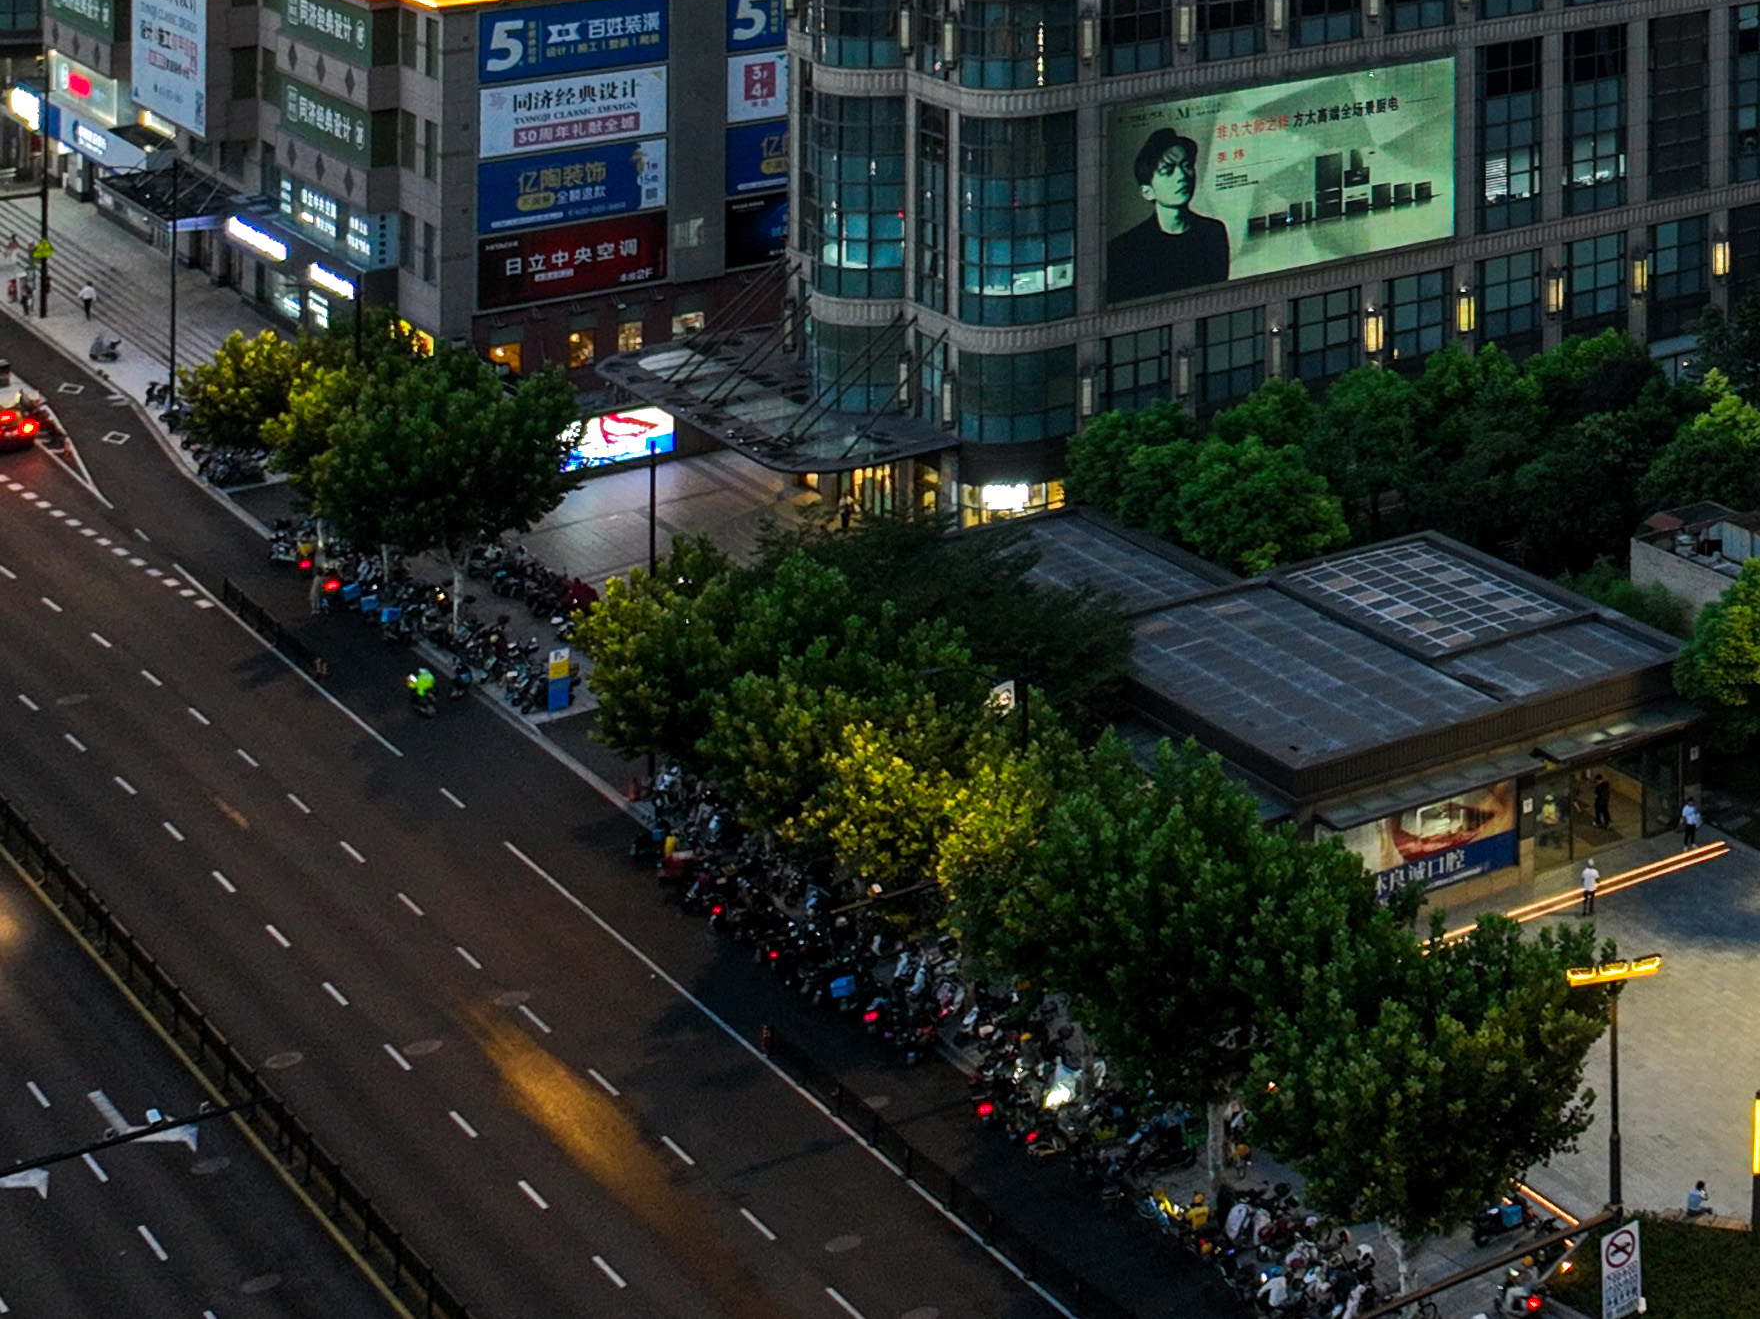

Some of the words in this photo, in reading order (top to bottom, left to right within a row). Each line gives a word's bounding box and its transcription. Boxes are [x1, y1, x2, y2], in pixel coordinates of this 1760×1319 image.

[588, 11, 660, 39] 百姓装潢
[486, 19, 525, 72] 5
[513, 78, 637, 113] 同济经典设计
[518, 115, 635, 143] 30周年礼献全城
[1216, 114, 1290, 141] 非凡大师之作
[1292, 96, 1398, 128] 方太高端全场景厨电
[518, 162, 607, 193] 亿陶装饰
[505, 238, 637, 276] 日立中央空调
